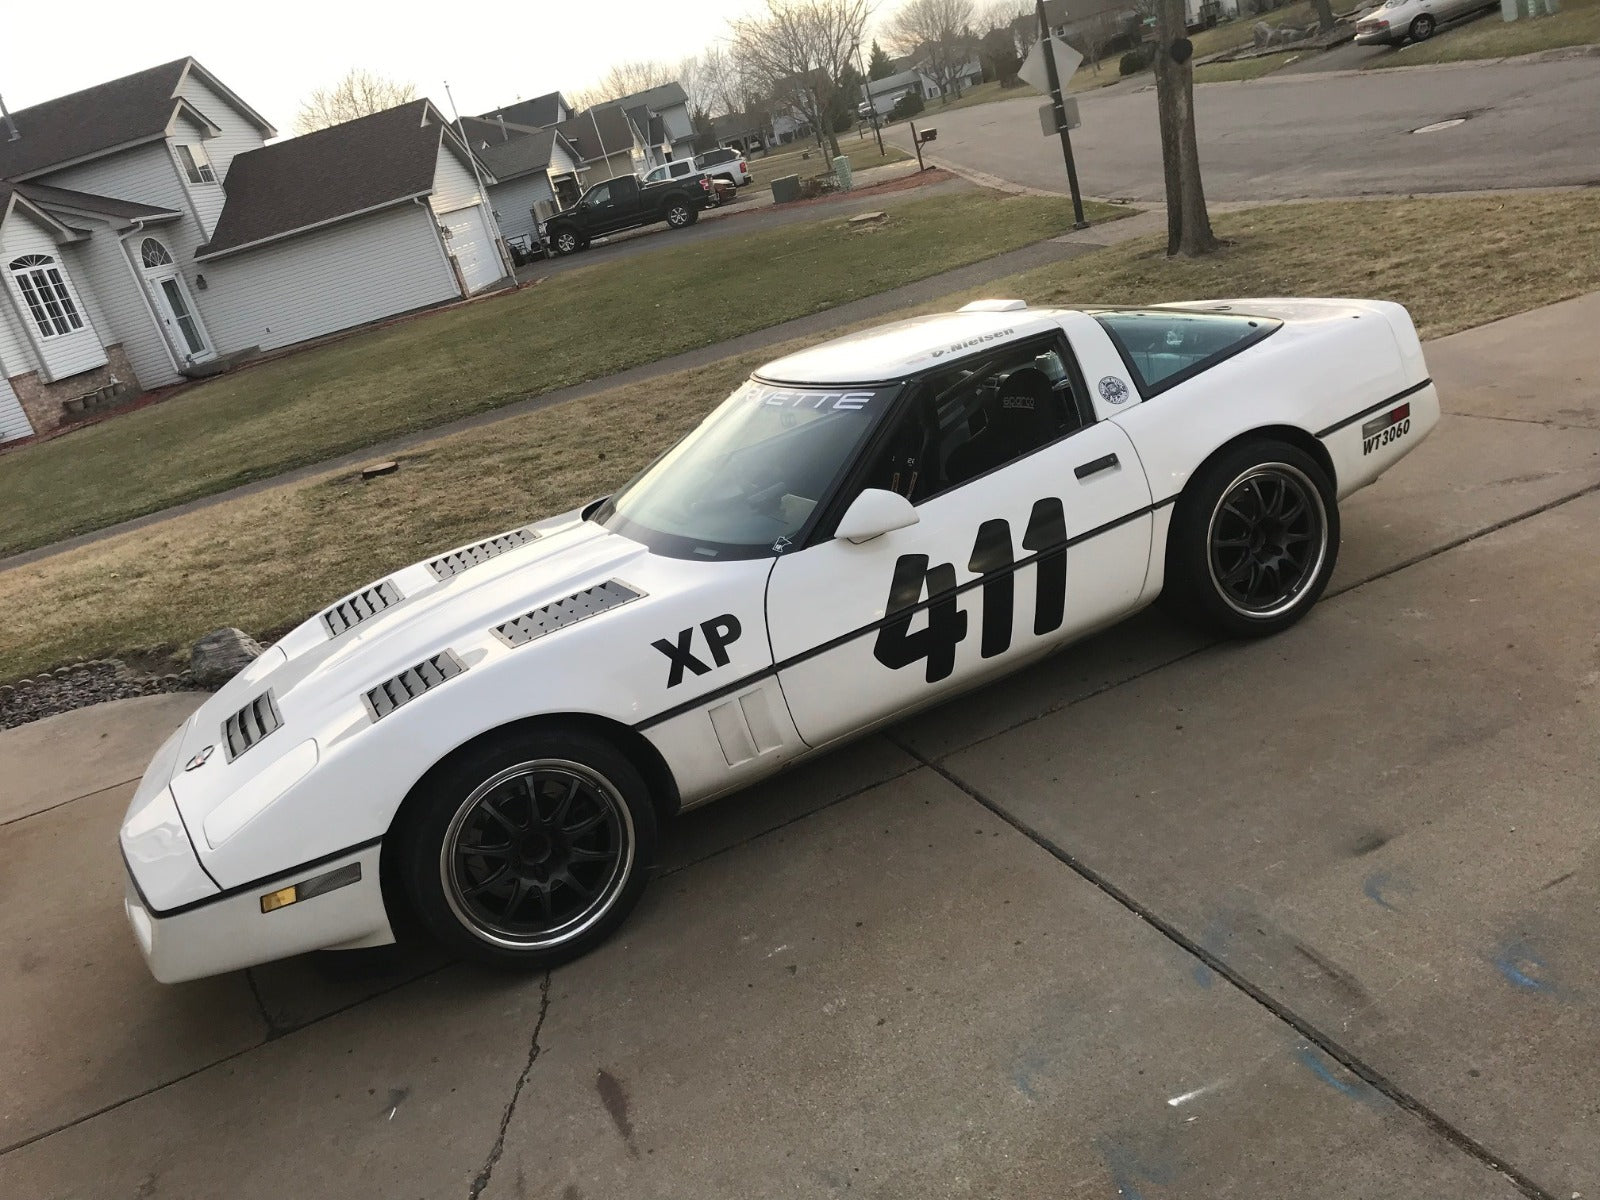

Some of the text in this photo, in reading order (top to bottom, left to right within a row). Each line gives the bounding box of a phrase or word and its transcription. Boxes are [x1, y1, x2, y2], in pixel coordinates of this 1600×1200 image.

[1363, 419, 1410, 456] WT3060
[873, 496, 1068, 684] 411
[650, 613, 742, 689] XP
